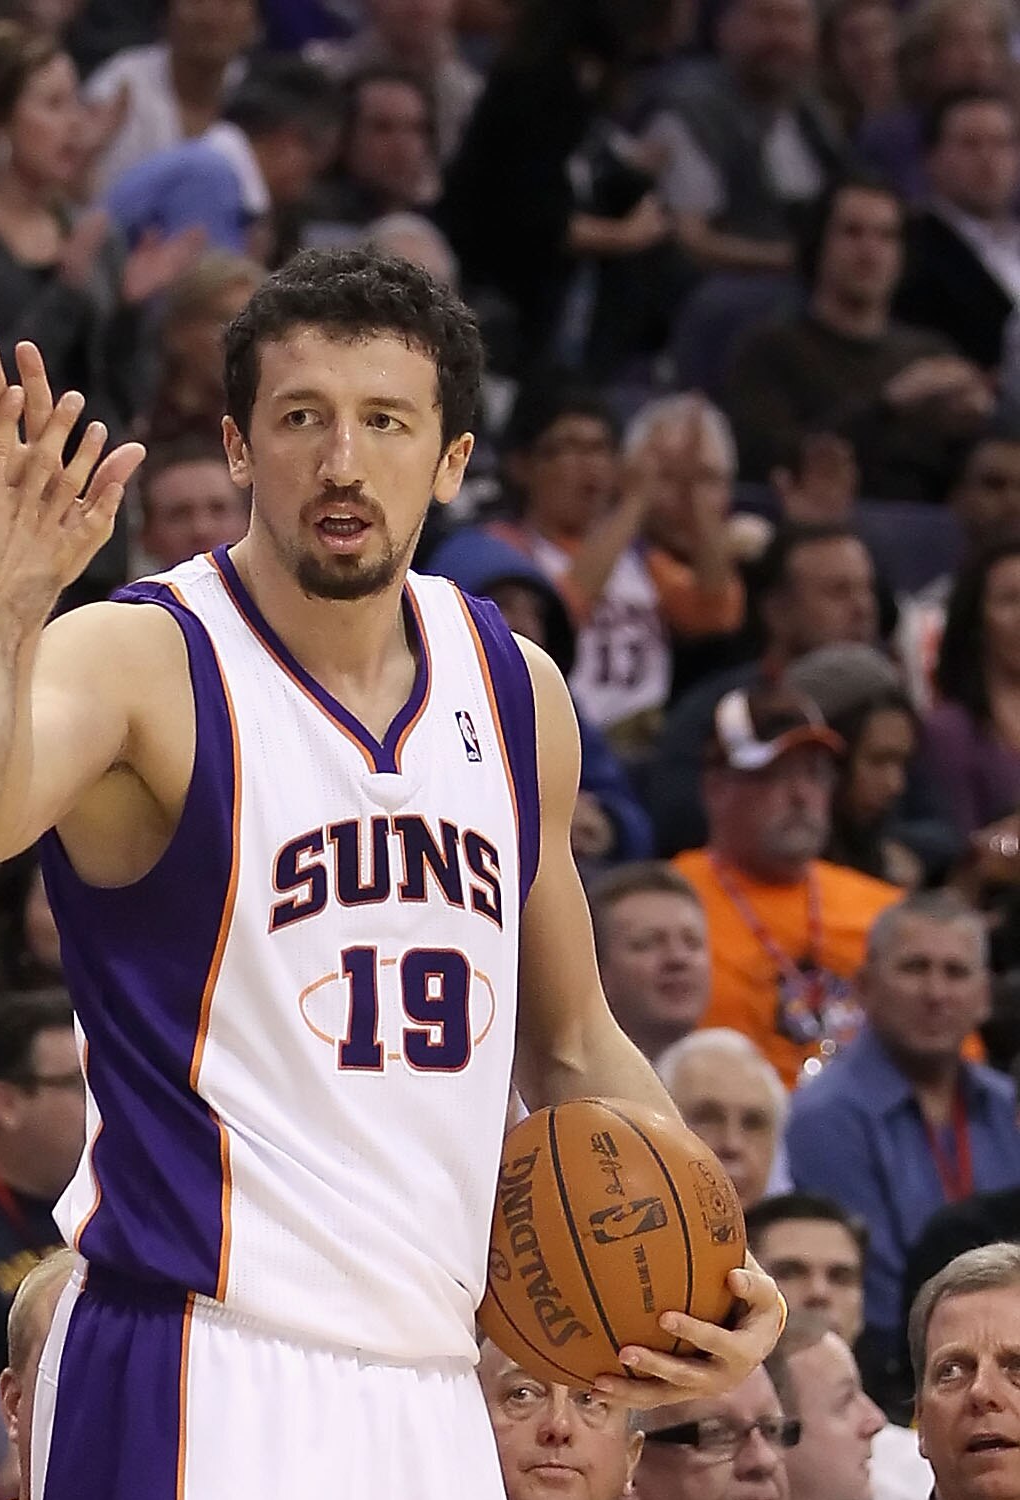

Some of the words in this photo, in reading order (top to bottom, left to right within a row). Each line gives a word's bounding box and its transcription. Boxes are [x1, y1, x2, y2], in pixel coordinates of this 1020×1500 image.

[268, 814, 503, 933] SUNS
[338, 945, 472, 1072] 19
[497, 1146, 593, 1347] SPALDING
